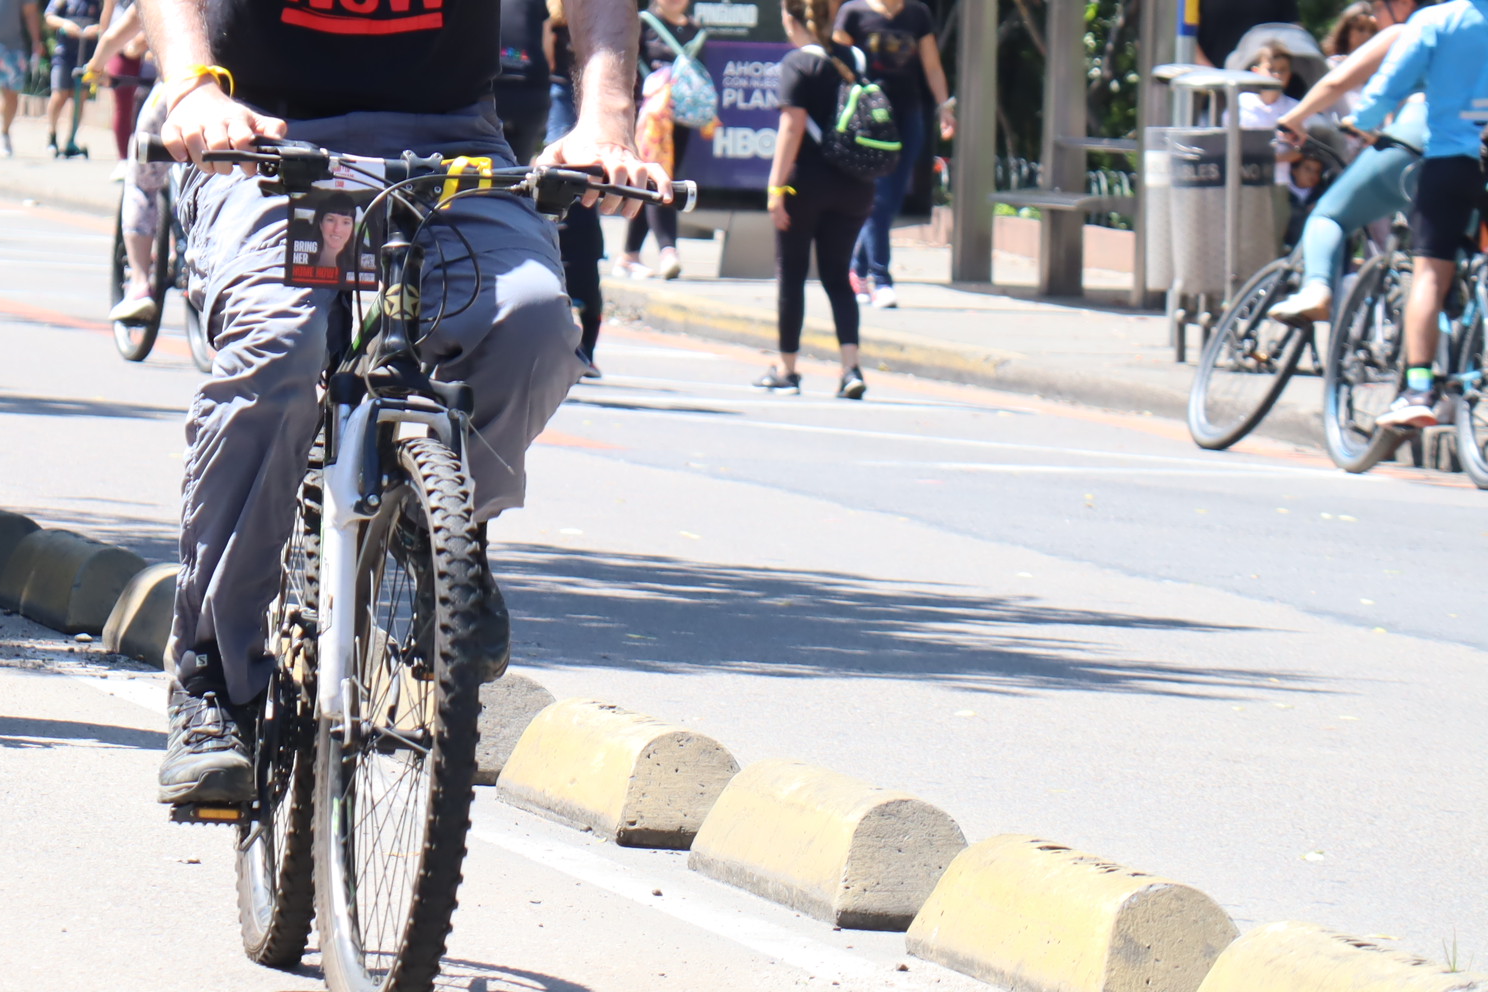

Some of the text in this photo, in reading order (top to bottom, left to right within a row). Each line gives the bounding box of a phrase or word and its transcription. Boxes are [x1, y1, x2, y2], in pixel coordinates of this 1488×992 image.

[713, 127, 777, 159] HBO
[294, 240, 318, 254] BRING
[293, 253, 309, 265] HER
